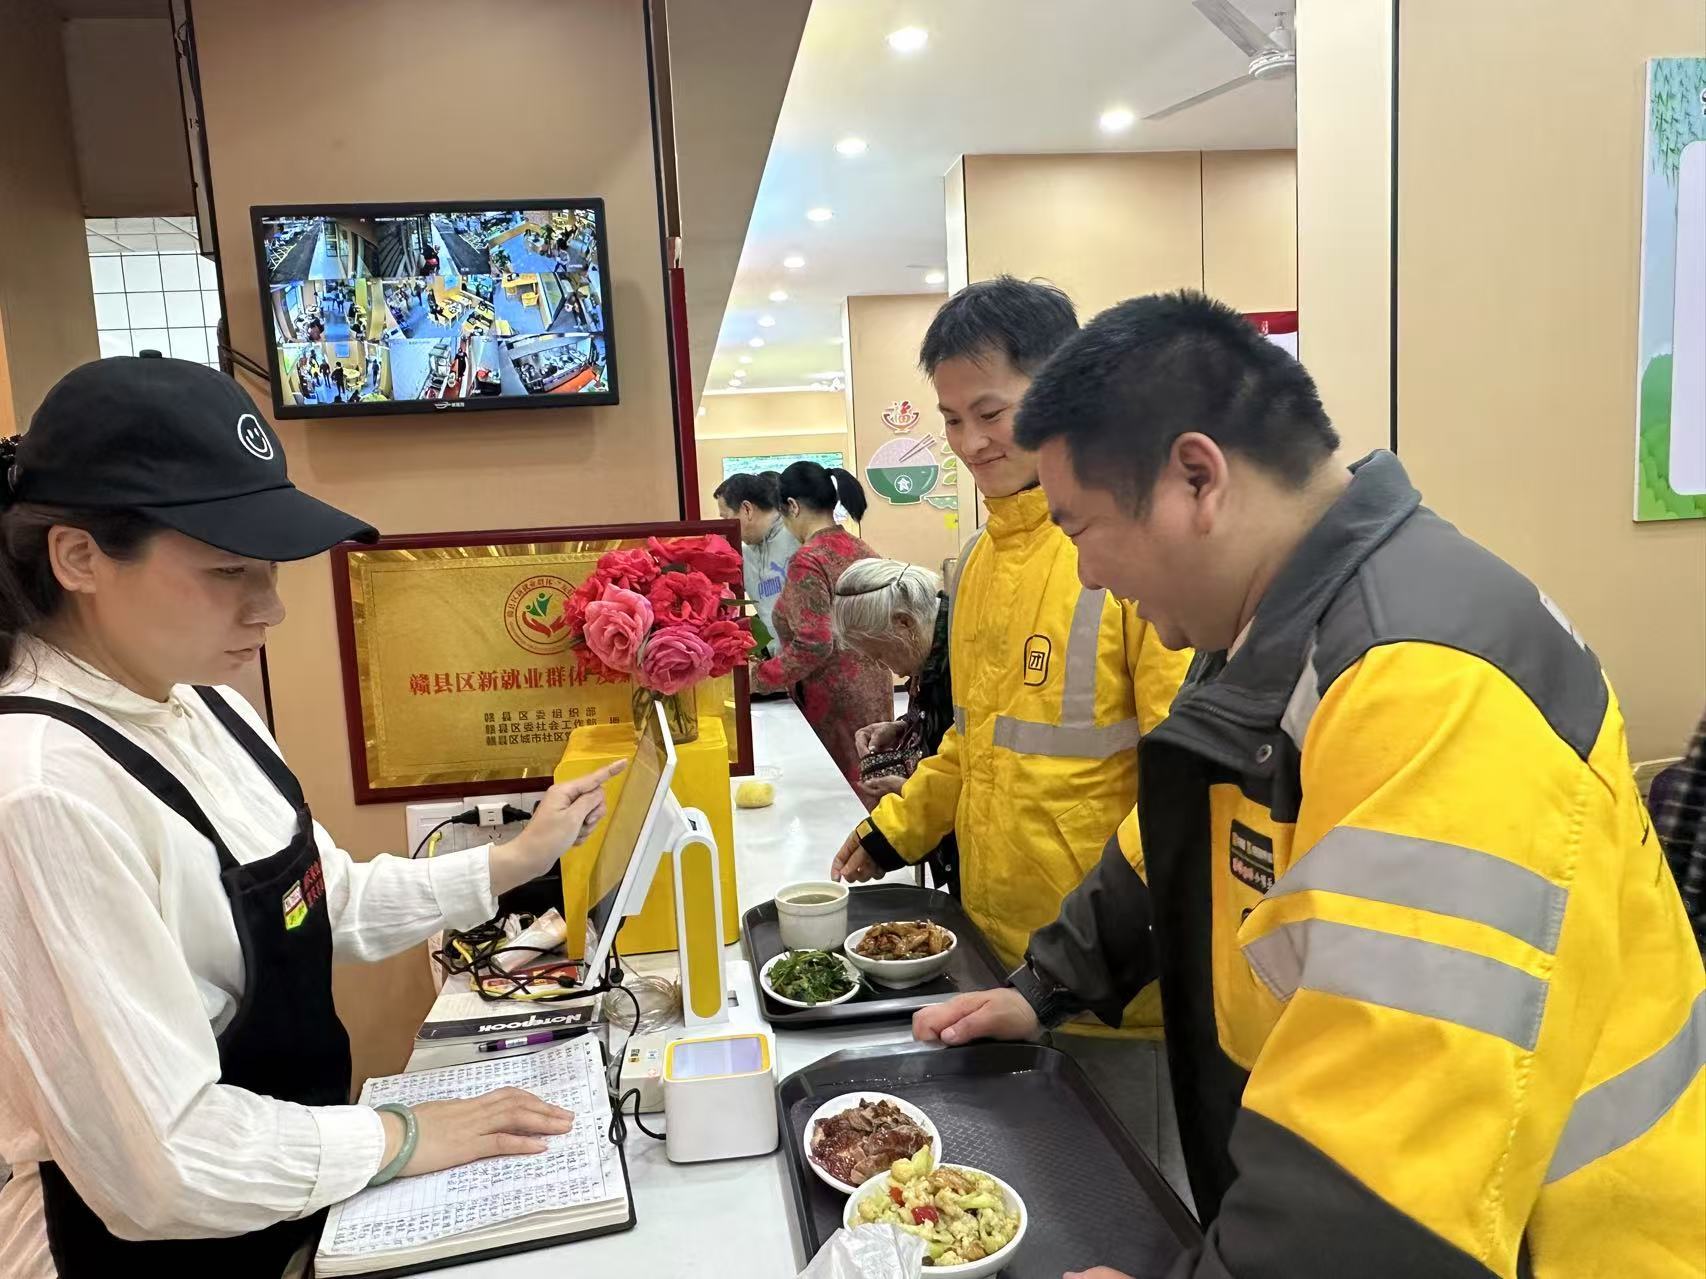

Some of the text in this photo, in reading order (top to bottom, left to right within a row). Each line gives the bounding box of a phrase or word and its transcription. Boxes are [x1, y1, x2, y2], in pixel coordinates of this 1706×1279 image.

[409, 665, 630, 697] 赣县区新就业群体
